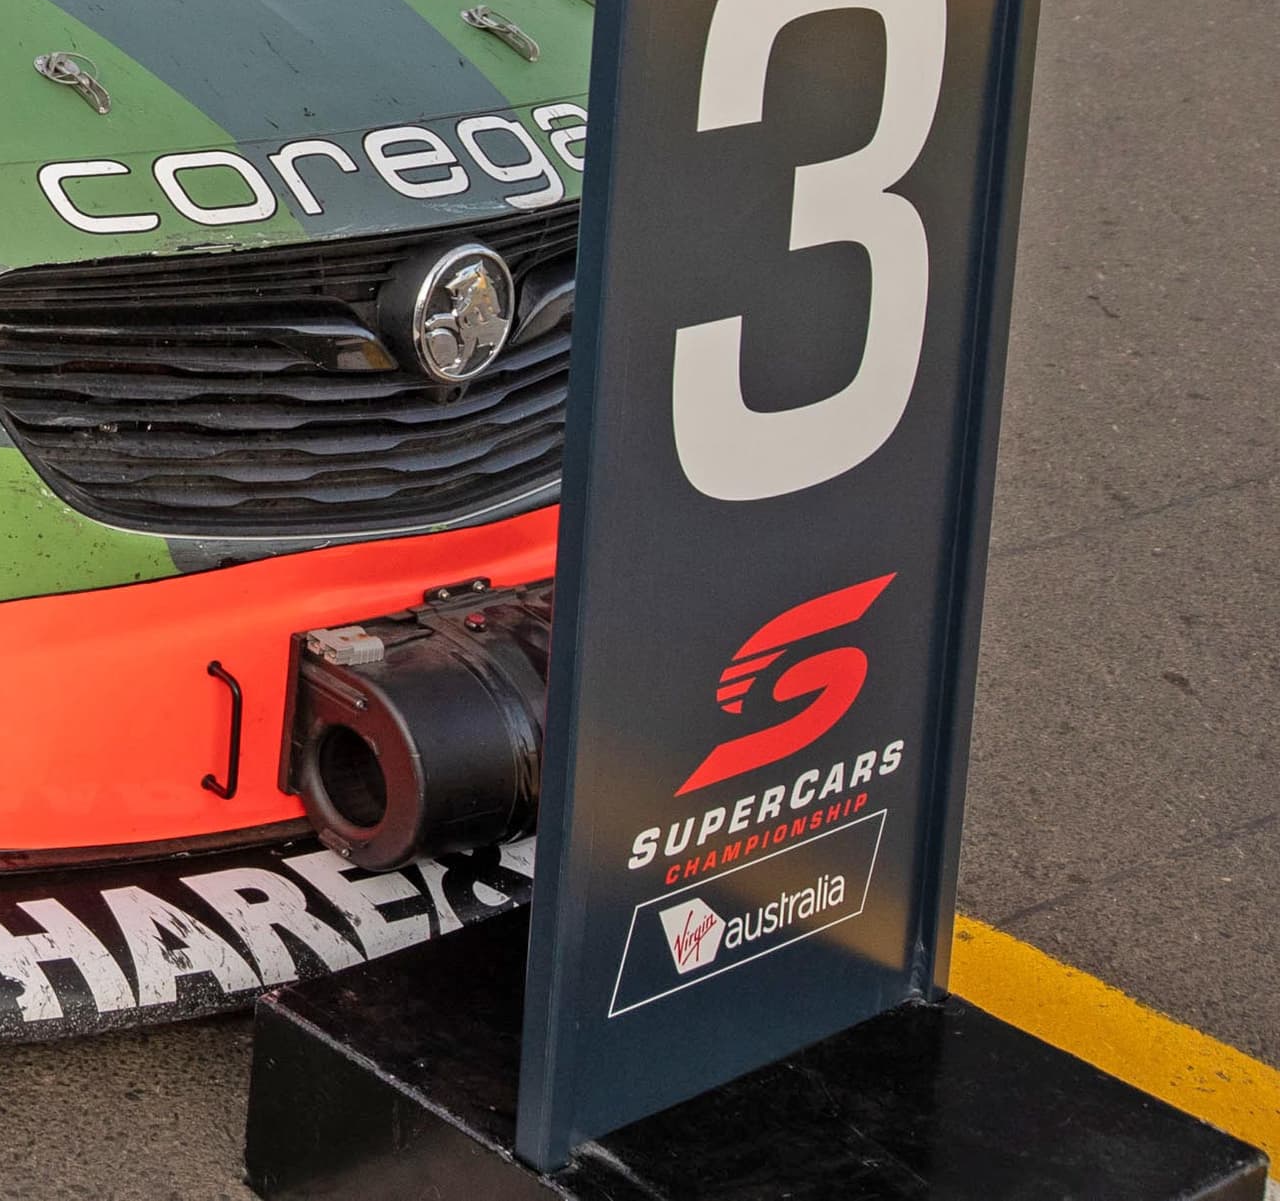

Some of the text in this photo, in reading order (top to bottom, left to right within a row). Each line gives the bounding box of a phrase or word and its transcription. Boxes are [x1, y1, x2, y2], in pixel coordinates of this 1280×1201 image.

[40, 103, 587, 236] corega
[628, 739, 904, 870] SUPERCARS
[665, 793, 868, 884] CHAMPIONSHIP
[674, 874, 845, 966] Virgin australia
